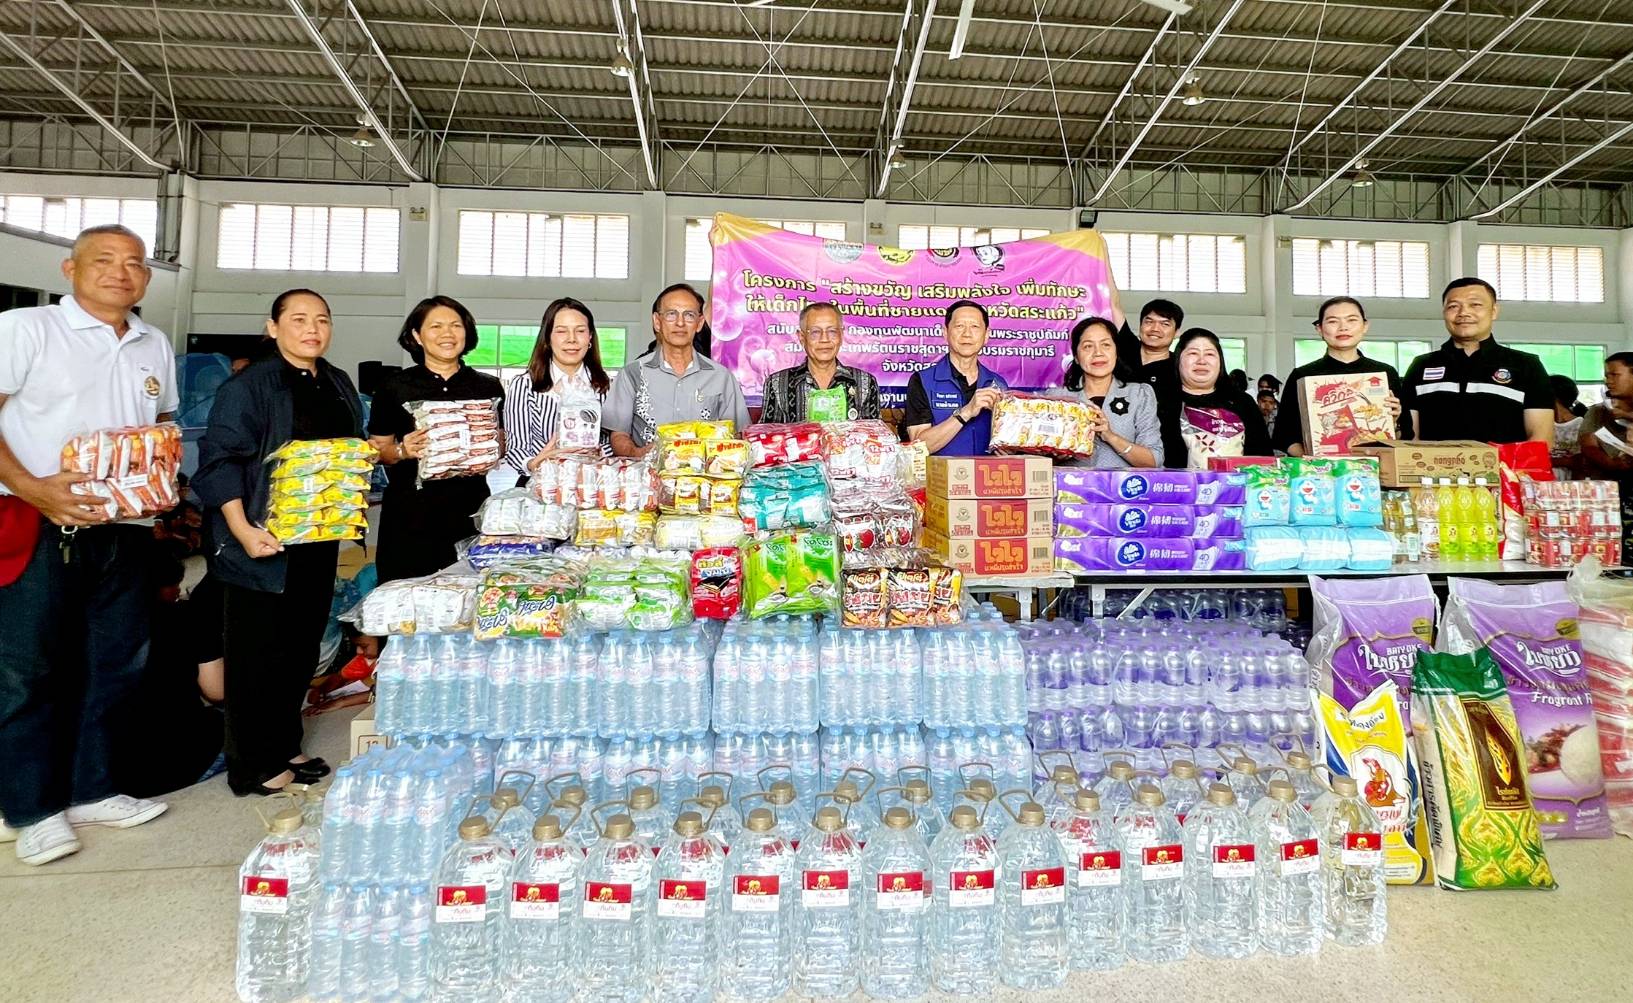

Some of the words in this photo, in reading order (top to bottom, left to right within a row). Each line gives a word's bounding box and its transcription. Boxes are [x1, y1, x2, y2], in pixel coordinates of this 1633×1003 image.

[743, 269, 817, 292] โครงการ
[821, 277, 912, 301] "สร้างขวัญ
[917, 283, 1011, 299] เสริมพลังใจ
[1016, 278, 1087, 298] เพิ่มทักษะ
[978, 464, 1022, 486] ไวไว
[980, 504, 1025, 527] ไวไว
[980, 540, 1024, 564] ไวไว
[1358, 644, 1416, 672] ใบหย
[1531, 691, 1583, 708] Fragrant
